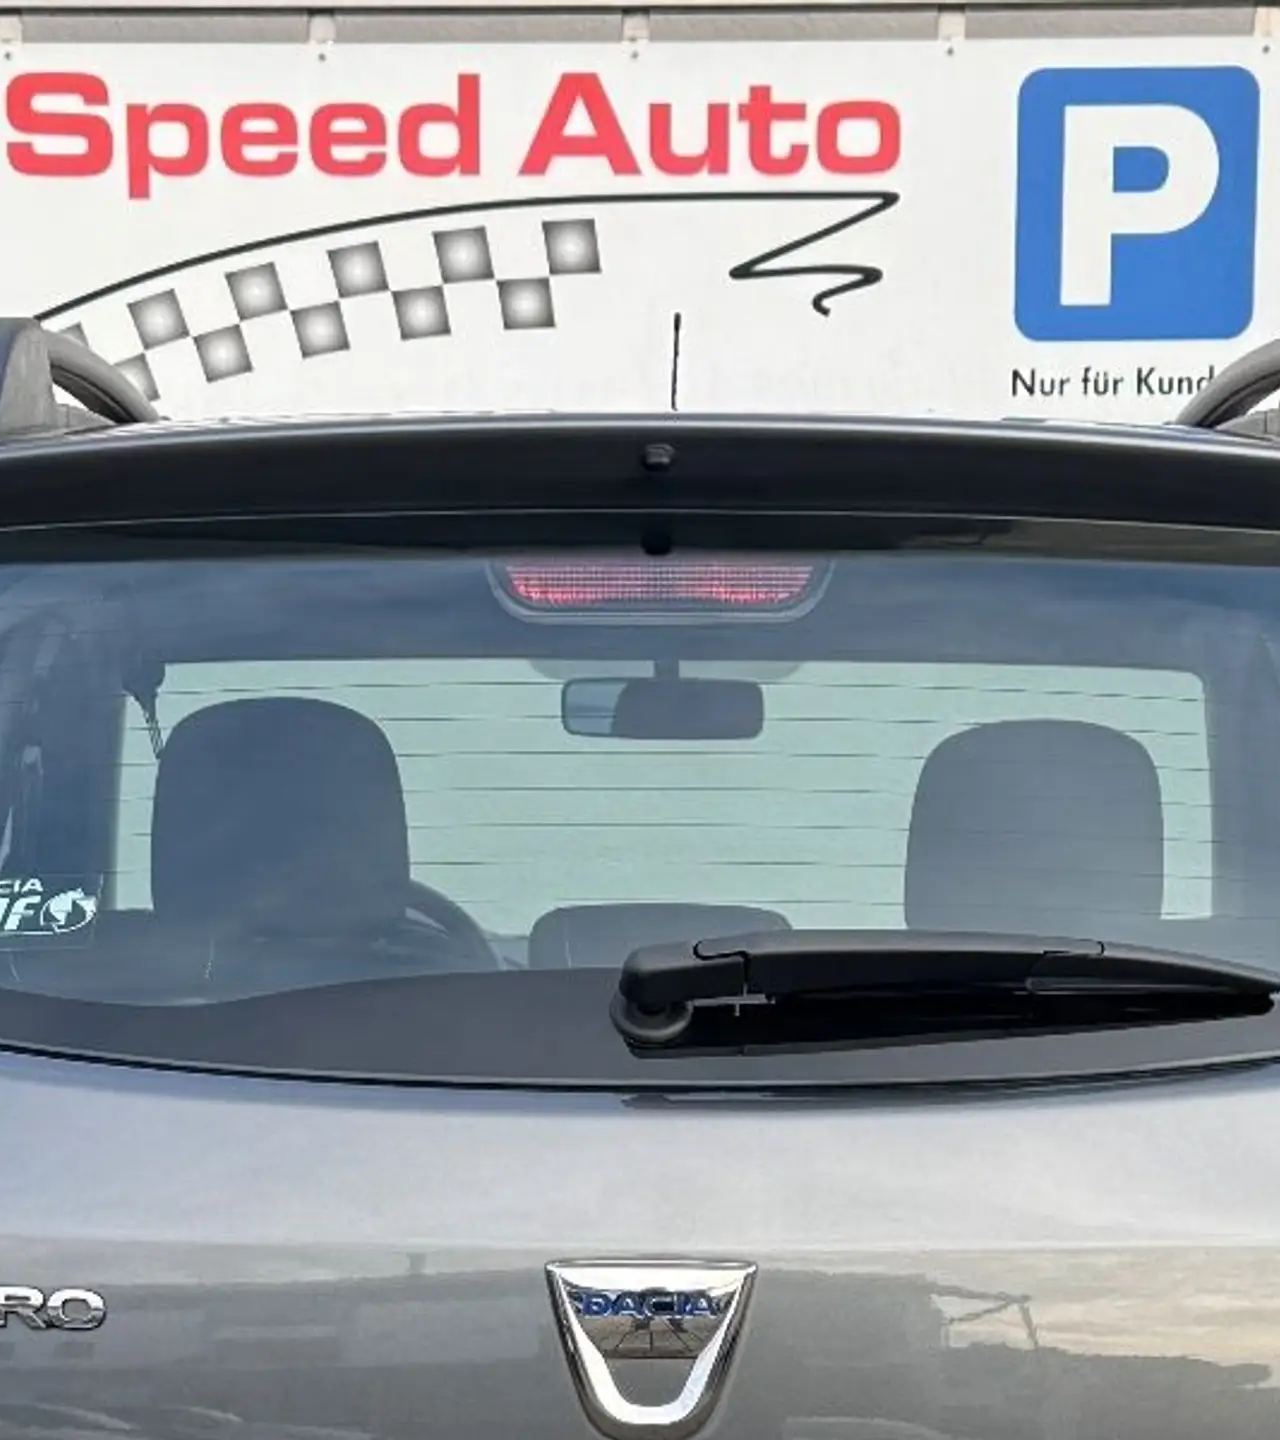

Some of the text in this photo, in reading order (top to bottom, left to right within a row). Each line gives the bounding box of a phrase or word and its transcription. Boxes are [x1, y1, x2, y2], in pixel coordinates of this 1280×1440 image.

[5, 71, 902, 200] Speed Auto
[1059, 103, 1221, 308] P
[1011, 368, 1071, 397] Nur
[1082, 366, 1124, 396] für
[580, 1290, 720, 1320] DACIA
